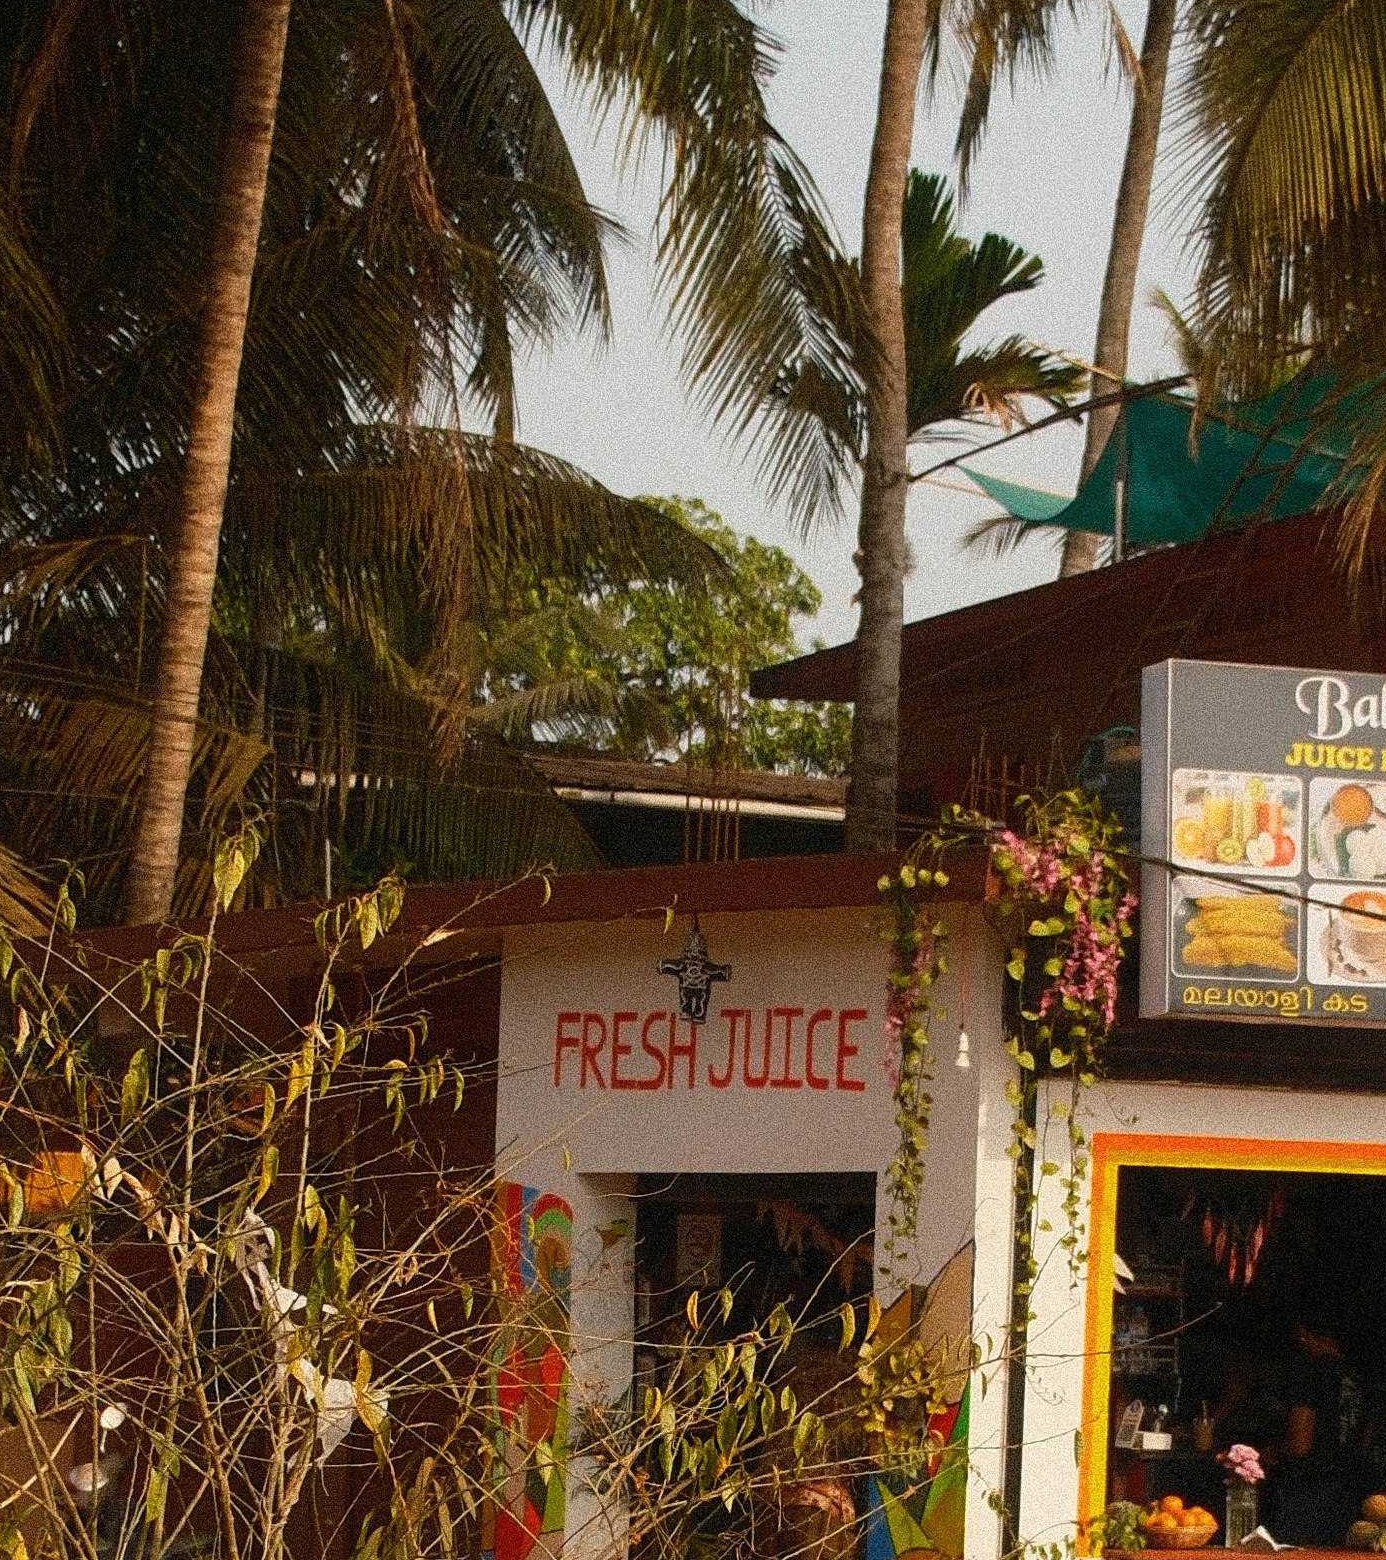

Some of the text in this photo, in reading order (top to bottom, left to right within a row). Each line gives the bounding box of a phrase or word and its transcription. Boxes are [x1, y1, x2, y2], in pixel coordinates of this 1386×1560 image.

[1285, 743, 1374, 769] JUICE
[553, 1008, 867, 1090] FRESH JUICE
